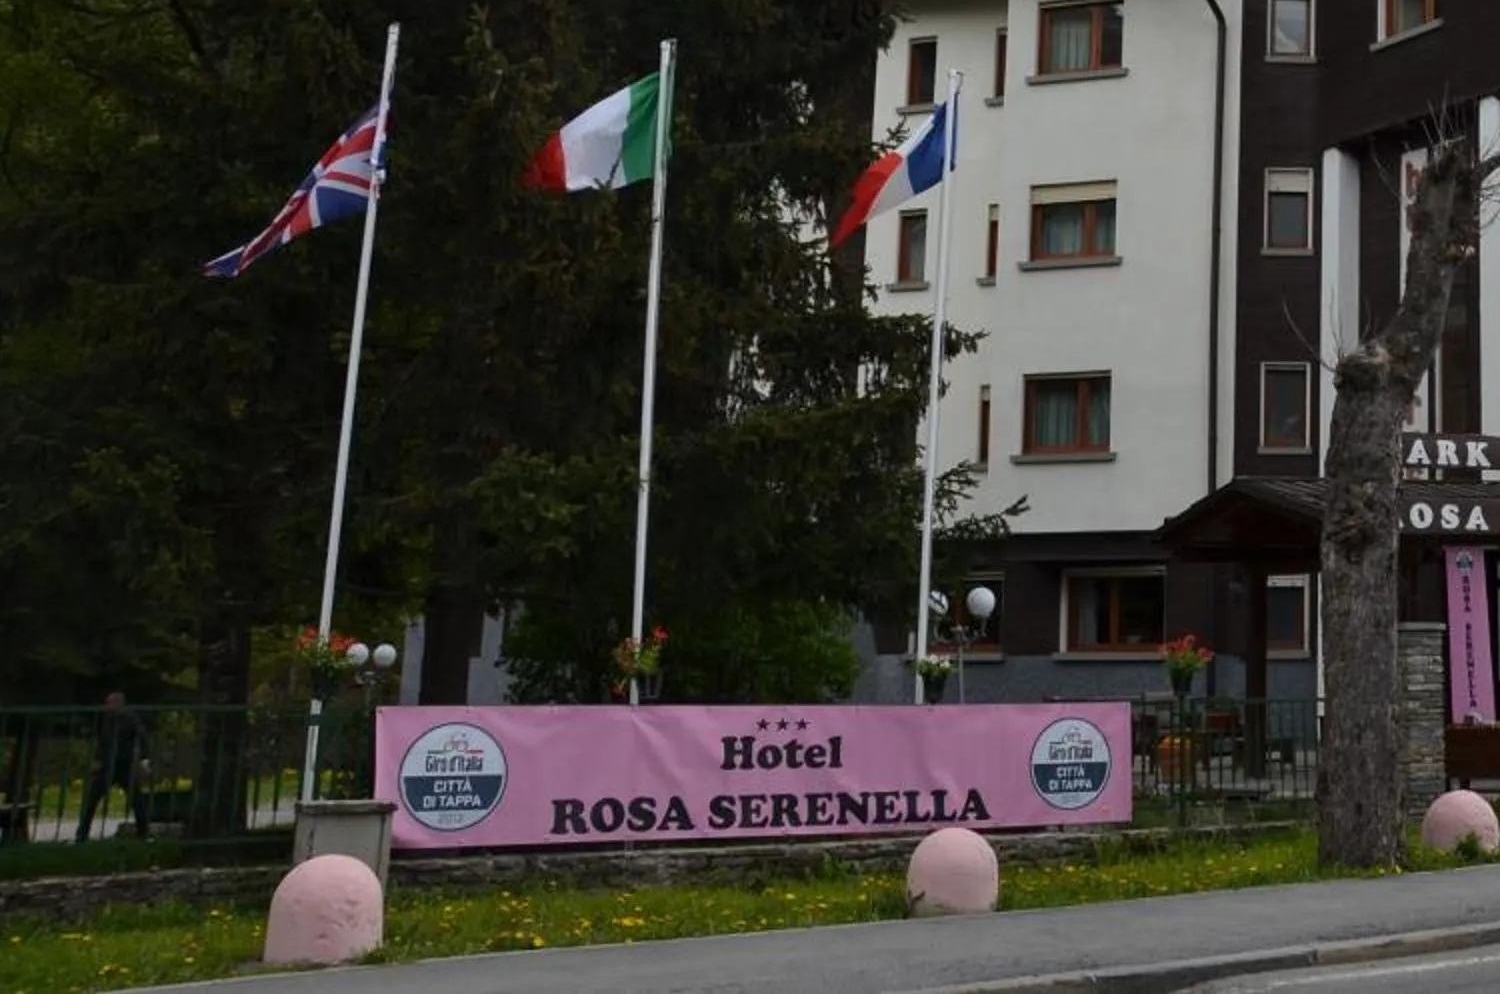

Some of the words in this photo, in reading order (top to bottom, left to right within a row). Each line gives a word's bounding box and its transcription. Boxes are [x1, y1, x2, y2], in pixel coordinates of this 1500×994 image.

[1405, 438, 1492, 467] ARK
[1398, 501, 1490, 532] OSA
[720, 735, 843, 771] Hotel
[1048, 780, 1060, 792] DI
[1061, 779, 1093, 791] TAPPA
[422, 795, 437, 809] DI
[438, 794, 481, 807] TAPPA
[549, 795, 696, 836] ROSA
[706, 787, 992, 831] SERENELLA
